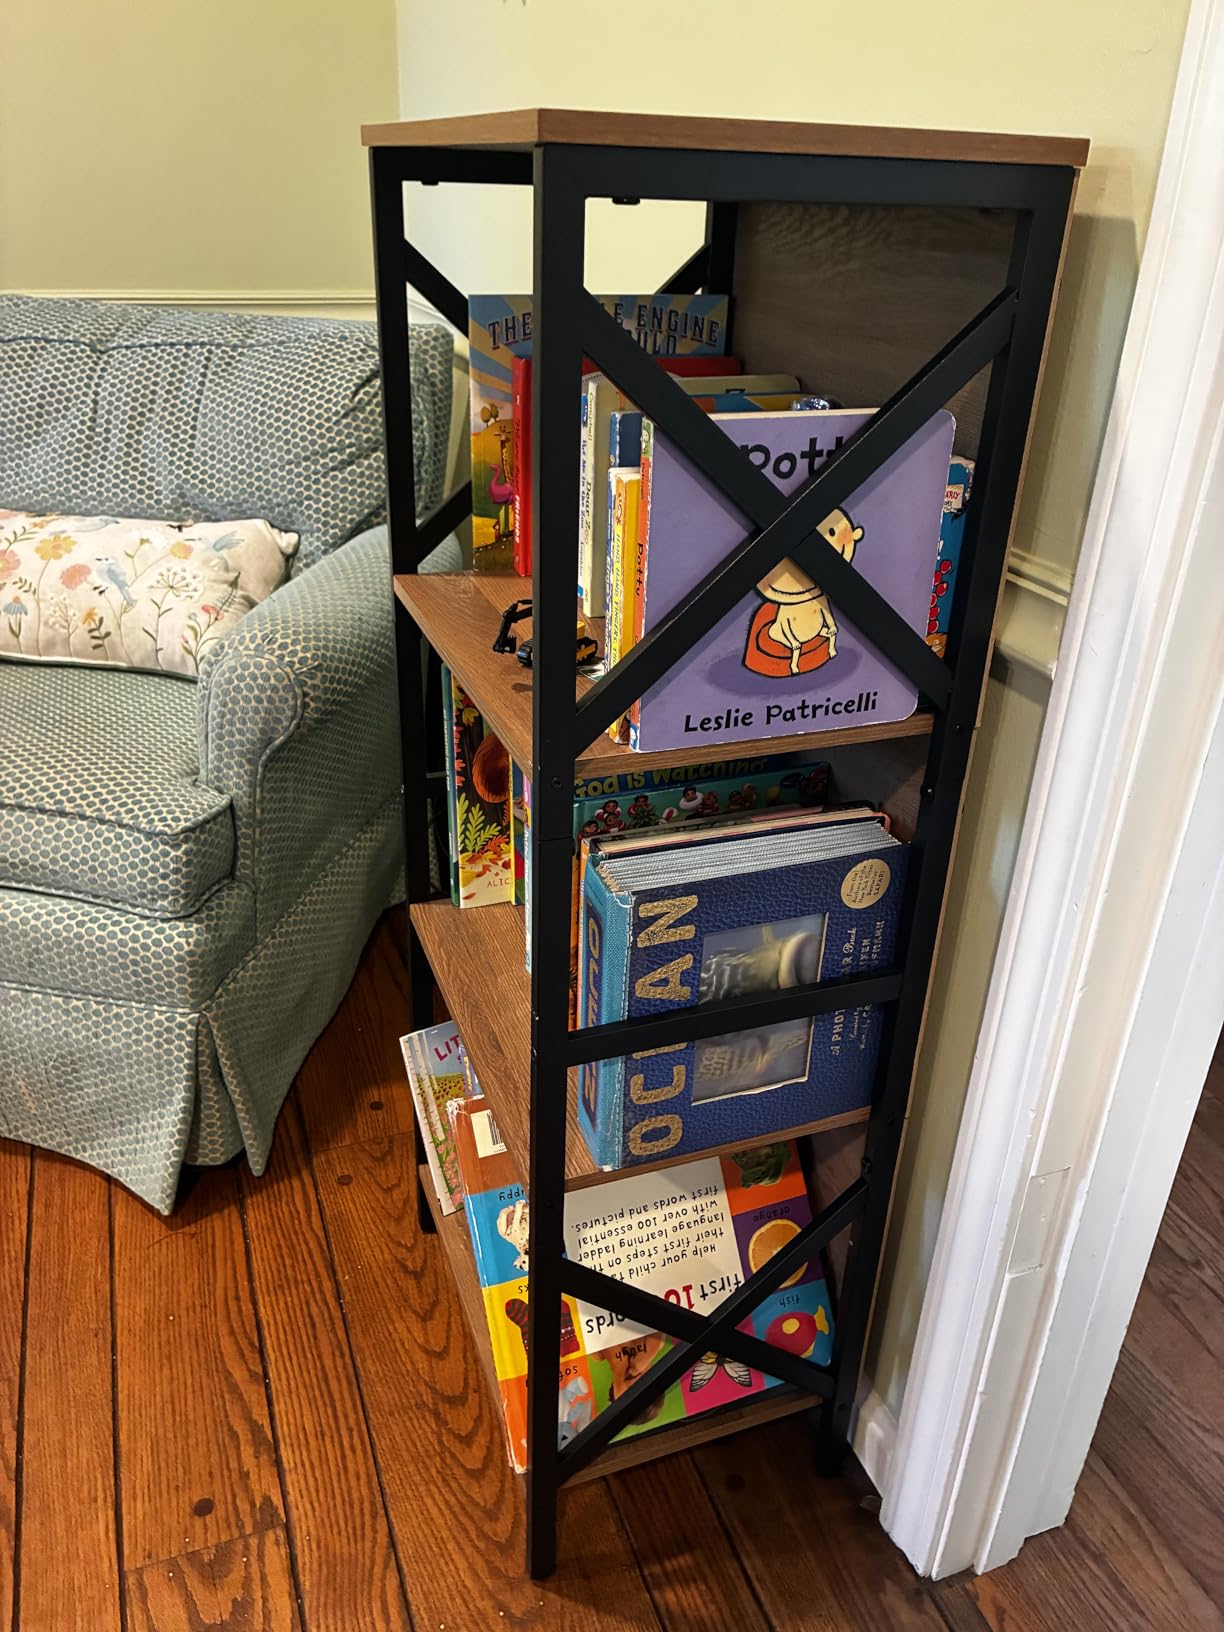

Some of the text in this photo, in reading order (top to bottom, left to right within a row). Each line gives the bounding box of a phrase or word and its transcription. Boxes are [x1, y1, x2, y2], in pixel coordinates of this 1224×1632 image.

[488, 312, 532, 350] THE
[636, 304, 719, 346] ENGINE
[635, 542, 643, 597] Potty
[684, 691, 878, 733] Leslie Patricelli
[487, 878, 511, 888] ALIC
[571, 1184, 719, 1233] first words and pictures.
[753, 1205, 791, 1223] orange
[578, 1199, 718, 1249] with over 100 essential
[578, 1211, 725, 1262] language learning ladder
[695, 1226, 725, 1243] their
[627, 1245, 658, 1263] steps
[663, 1237, 690, 1254] first
[692, 1244, 717, 1258] Help
[608, 1257, 622, 1268] on
[661, 1250, 688, 1268] your
[629, 1262, 656, 1280] child
[664, 1273, 742, 1310] first 10
[779, 1293, 801, 1308] fish
[615, 1342, 647, 1360] laugh
